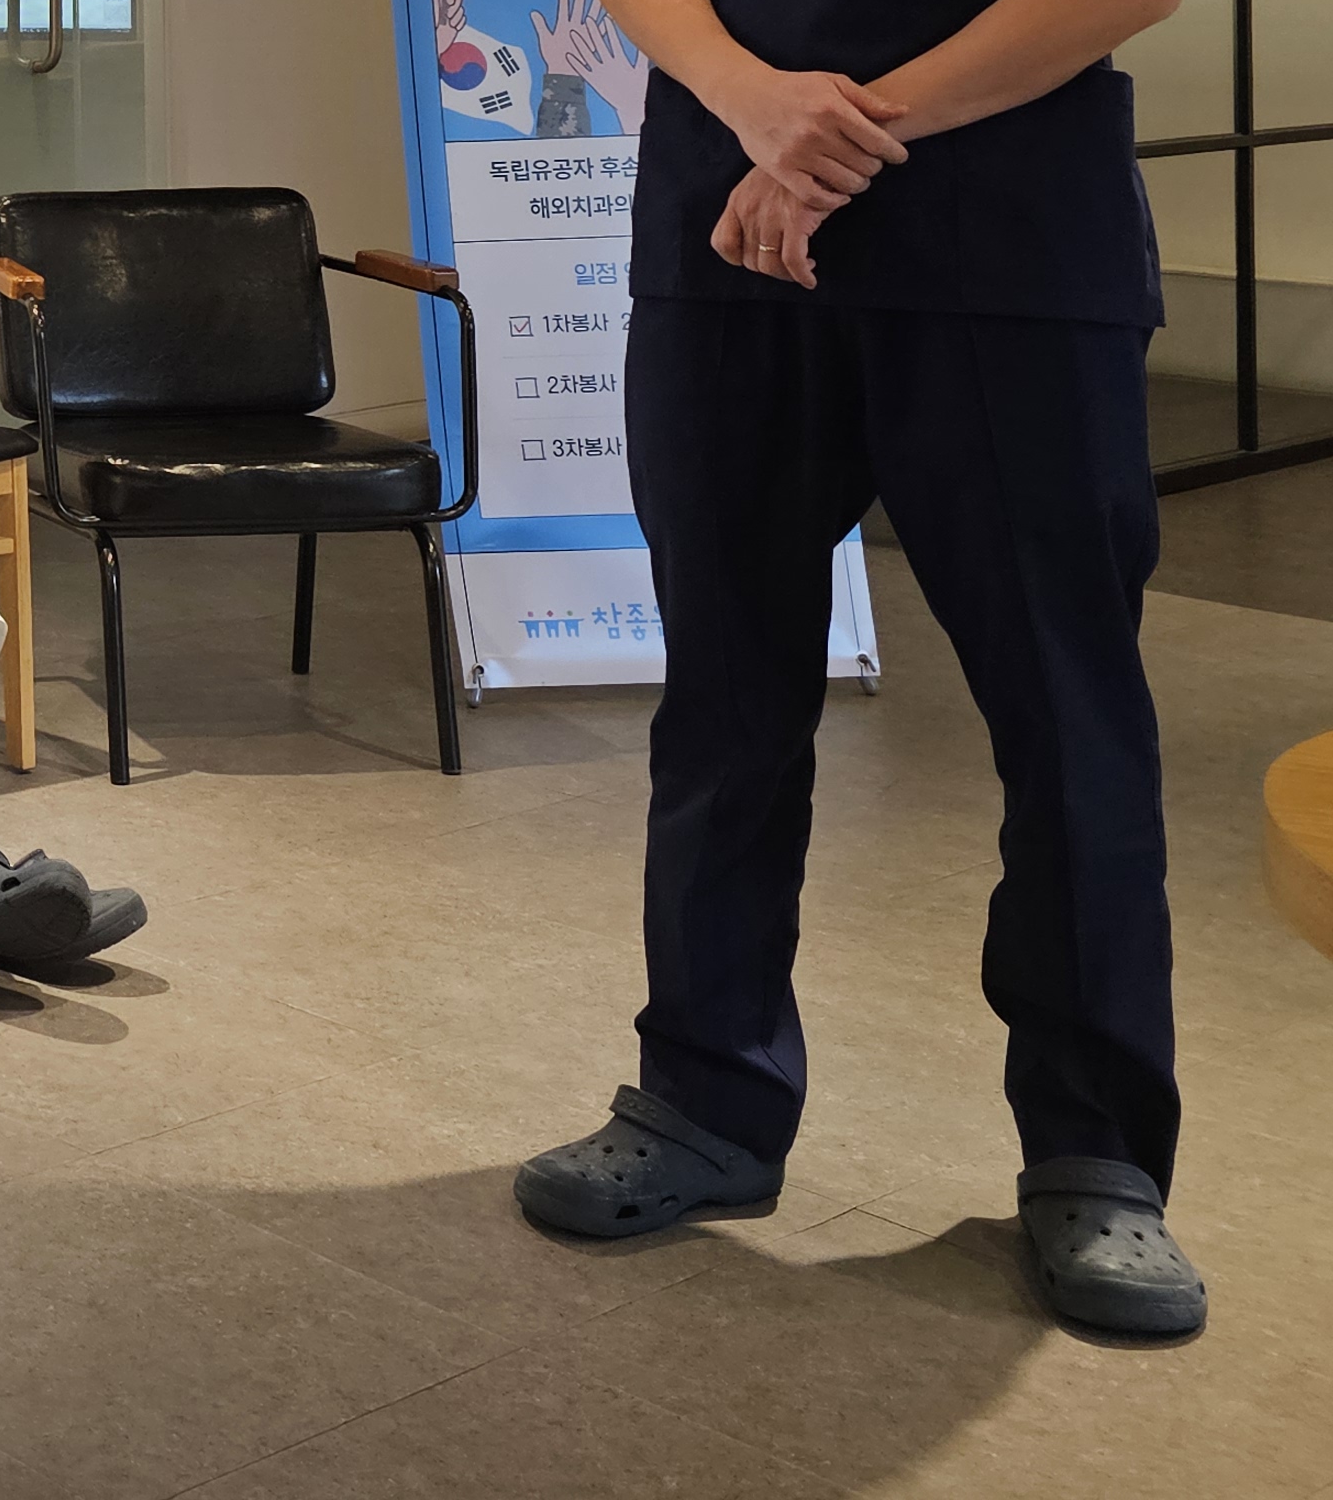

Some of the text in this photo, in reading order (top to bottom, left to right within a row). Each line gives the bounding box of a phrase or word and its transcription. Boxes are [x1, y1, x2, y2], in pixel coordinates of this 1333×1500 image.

[489, 157, 594, 182] 독립유공자
[529, 193, 632, 219] 해외치과의
[574, 262, 618, 286] 일정
[542, 313, 609, 333] 1차봉사
[547, 373, 617, 394] 2차봉사
[552, 437, 622, 457] 3차봉사
